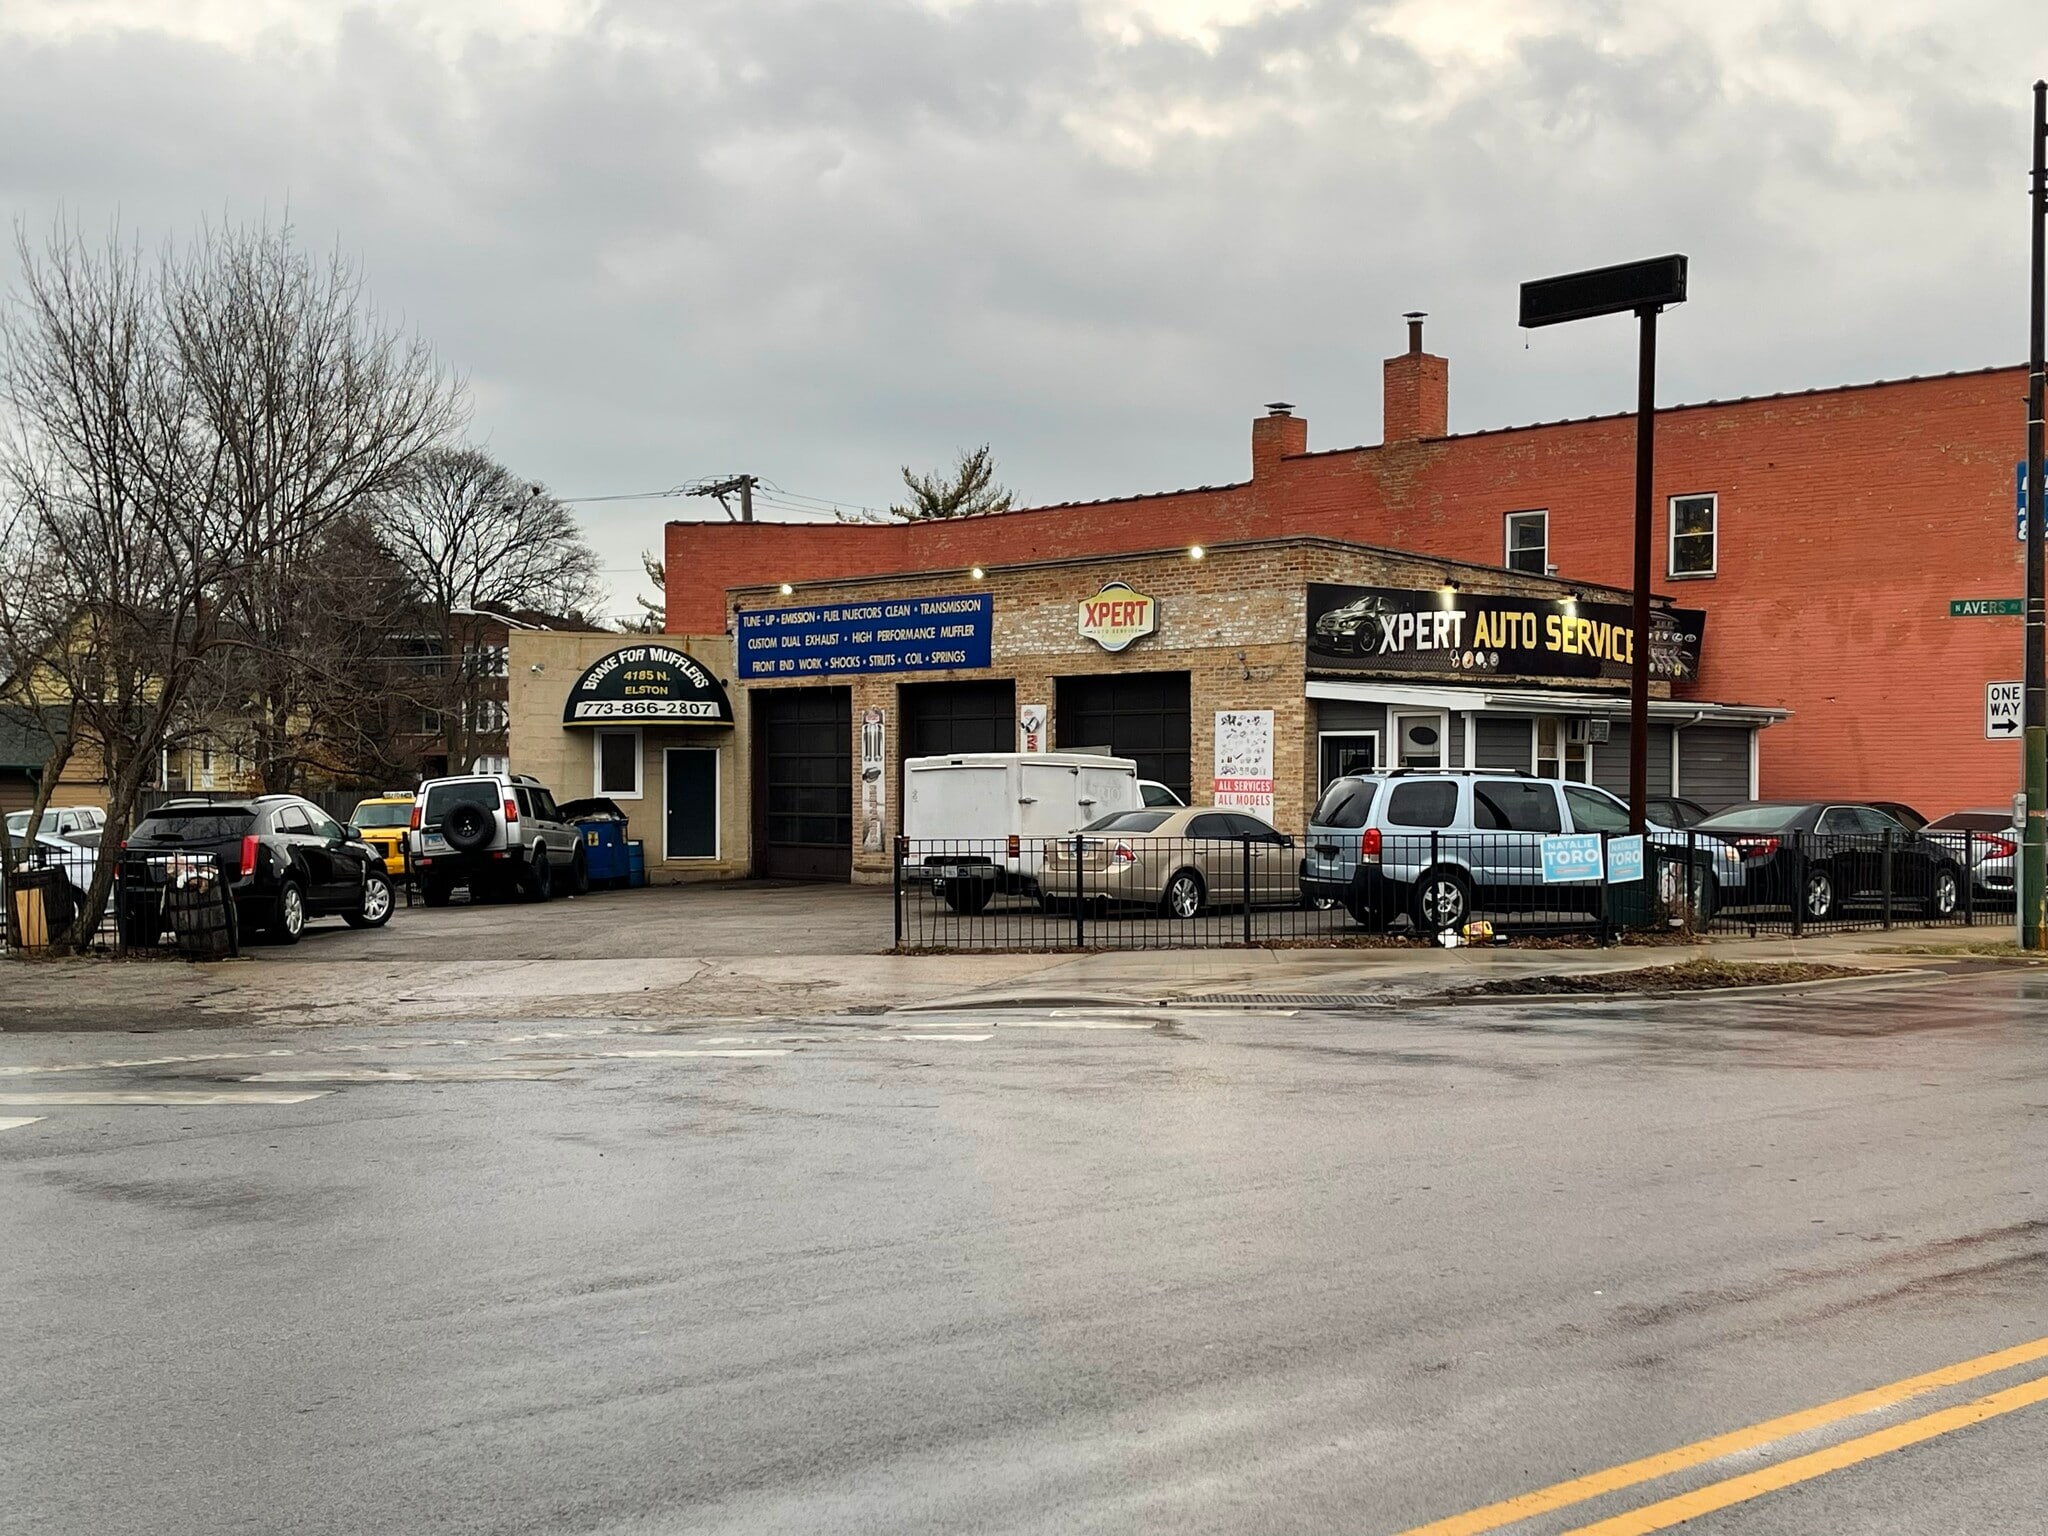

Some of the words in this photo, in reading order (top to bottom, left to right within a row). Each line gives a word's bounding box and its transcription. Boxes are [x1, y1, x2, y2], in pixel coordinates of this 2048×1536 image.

[781, 611, 816, 625] EMISSION
[823, 610, 840, 622] FUEL
[842, 606, 882, 620] INJECTORS
[885, 604, 911, 617] CLEAN
[920, 599, 981, 615] TRANSMISSION
[1084, 601, 1148, 627] XPERT
[1955, 604, 1960, 612] N
[1963, 601, 2006, 614] AVERS
[748, 637, 777, 650] CUSTOM
[781, 635, 801, 648] DUAL
[805, 633, 839, 646] EXHAUST
[852, 631, 872, 644] HIGH
[877, 627, 936, 642] PERFORMANCE
[940, 624, 975, 638] MUFFLER
[1378, 611, 1466, 655] XPERT
[1473, 611, 1537, 650] AUTO
[1545, 615, 1634, 665] SERVICE
[752, 660, 776, 672] FRONT
[779, 659, 795, 671] END
[799, 658, 822, 670] WORK
[830, 656, 860, 669] SHOCKS
[869, 654, 896, 667] STRUTS
[905, 652, 923, 665] COIL
[931, 650, 966, 664] SPRINGS
[582, 656, 619, 690] BRAKE
[618, 649, 646, 664] FOR
[649, 647, 709, 688] MUFFLERS
[623, 671, 653, 681] 4185
[656, 671, 671, 681] N.
[624, 686, 668, 695] ELSTON
[1991, 687, 2020, 700] ONE
[583, 702, 712, 715] 773-866-2807
[1990, 702, 2021, 716] WAY
[1218, 780, 1232, 791] ALL
[1233, 780, 1271, 792] SERVICES
[1218, 794, 1232, 806] ALL
[1236, 794, 1271, 806] MODELS
[1547, 839, 1593, 850] NATALIE
[1611, 840, 1639, 851] NATALIE
[1545, 848, 1598, 866] TORO
[1609, 850, 1641, 866] TORO
